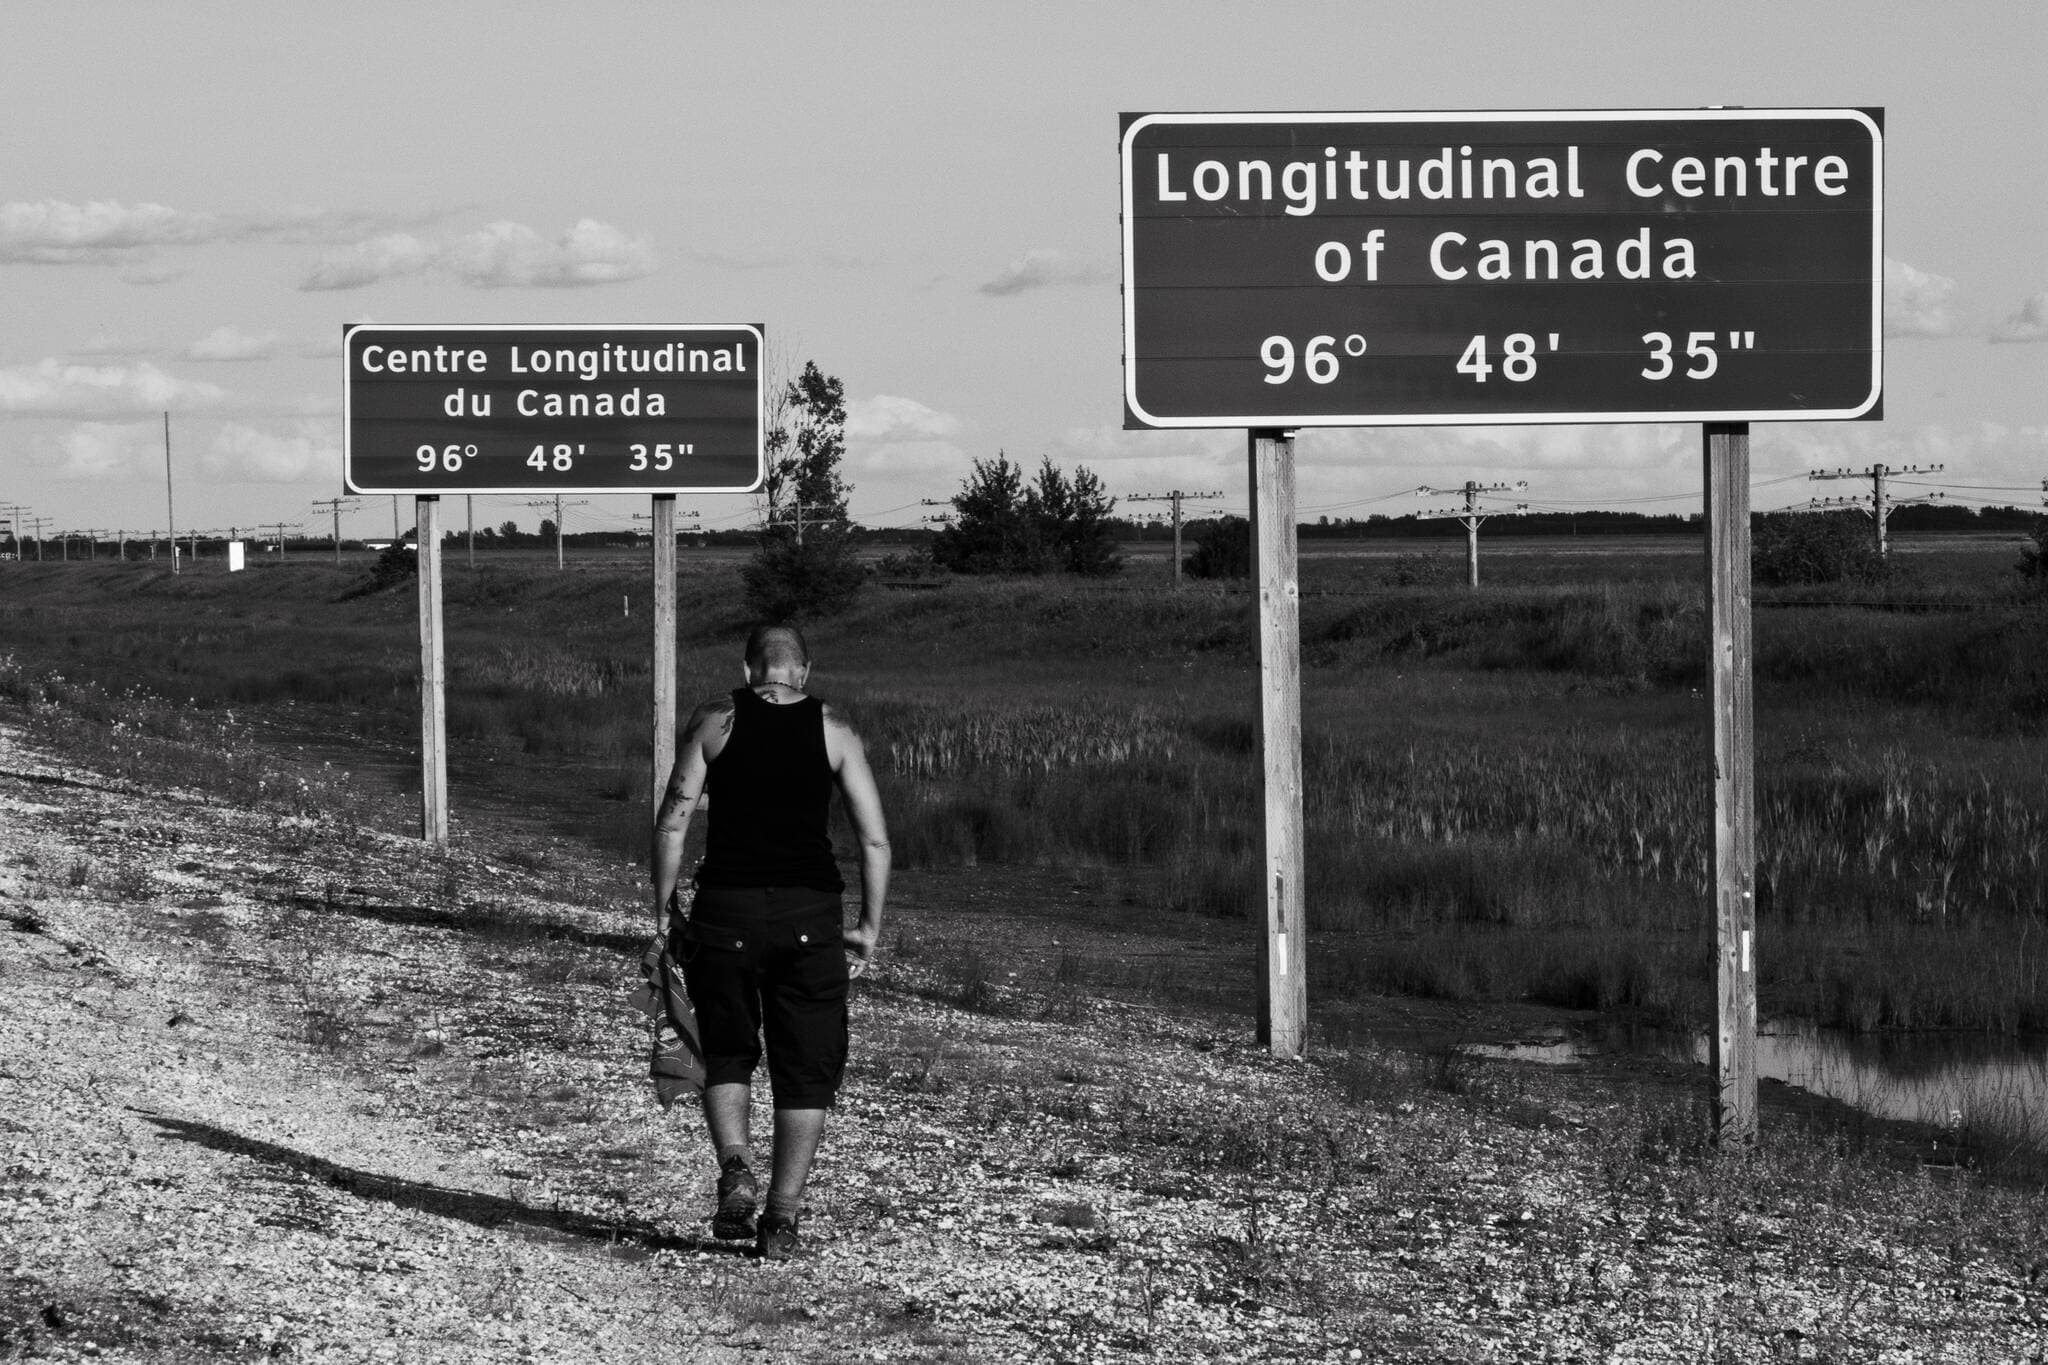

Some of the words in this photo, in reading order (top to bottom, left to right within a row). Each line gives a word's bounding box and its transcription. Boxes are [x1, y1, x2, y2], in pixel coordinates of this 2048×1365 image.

[1156, 145, 1585, 217] Longitudinal
[1625, 147, 1849, 198] Centre
[1314, 228, 1385, 283] of
[1429, 227, 1697, 281] Canada
[361, 345, 488, 373] Centre
[511, 342, 746, 381] Longitudinal
[444, 387, 491, 417] du
[516, 387, 666, 417] Canada
